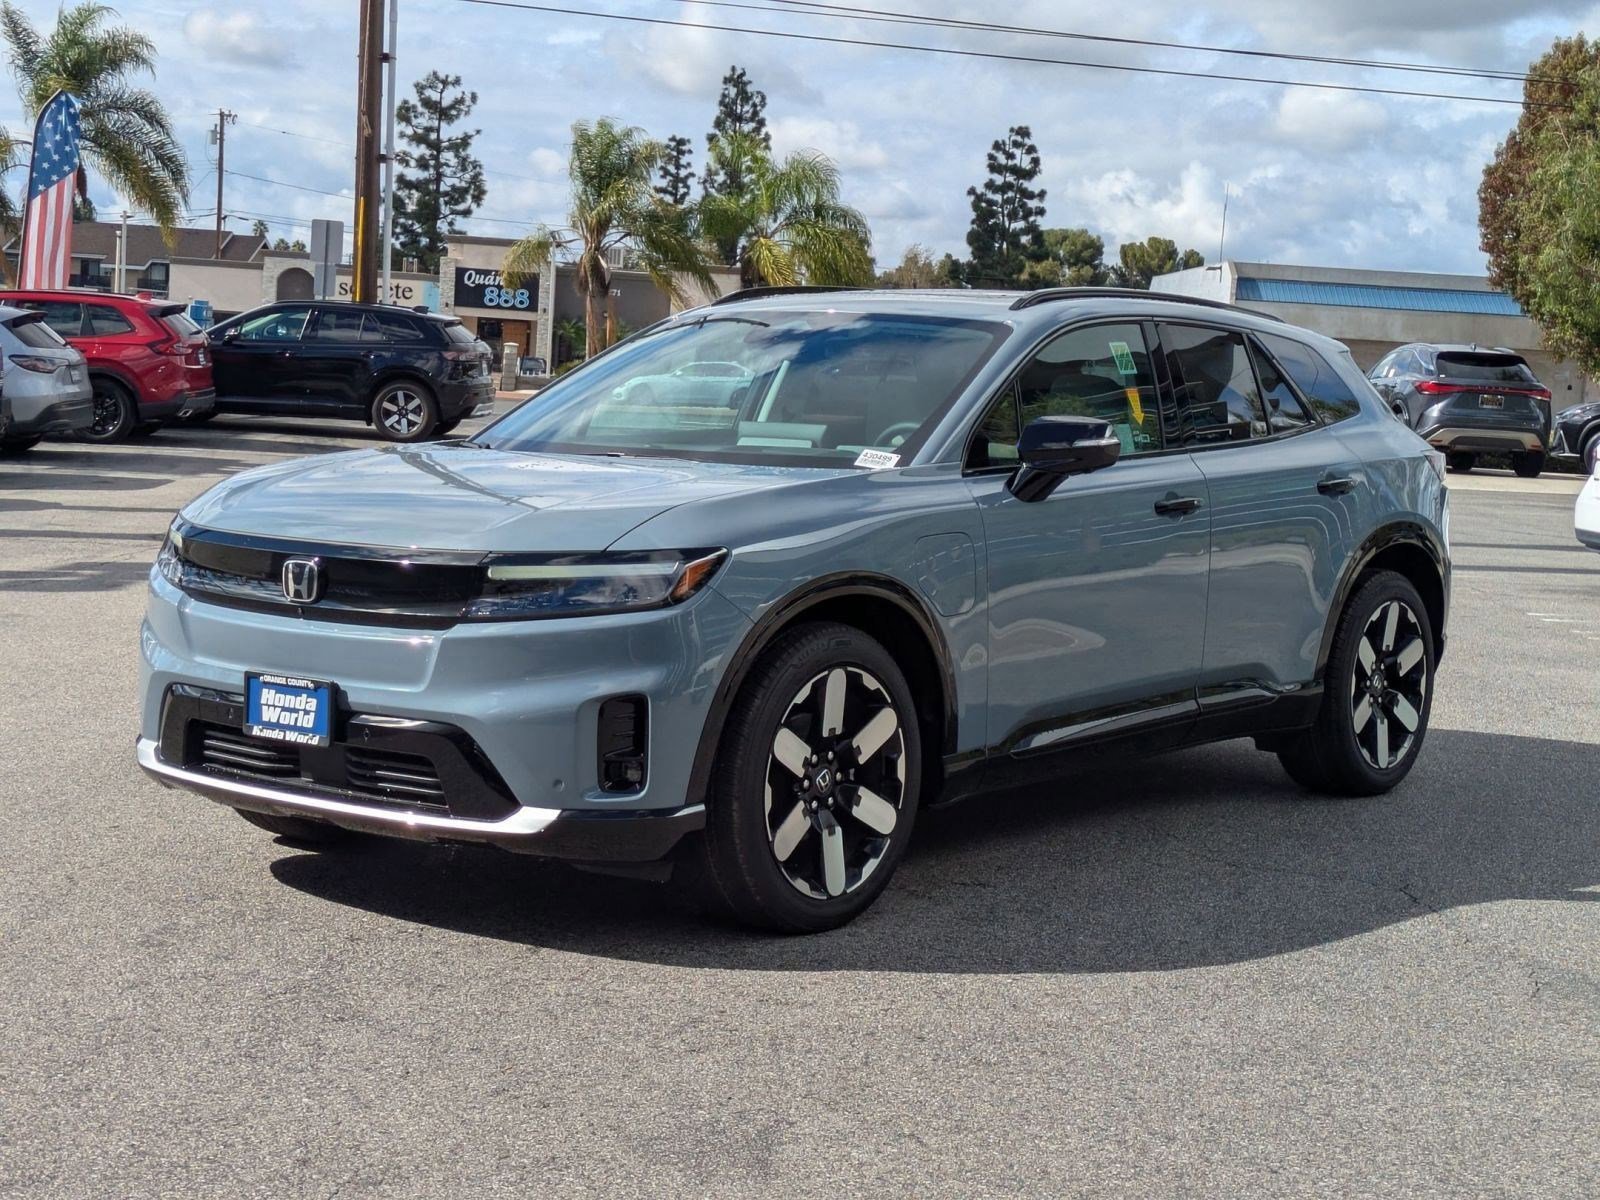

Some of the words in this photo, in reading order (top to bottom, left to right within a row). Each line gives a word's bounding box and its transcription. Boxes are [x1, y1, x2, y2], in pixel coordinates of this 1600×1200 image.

[484, 286, 530, 309] 888
[264, 675, 287, 685] ORANGE
[287, 678, 312, 687] COUNTY
[261, 688, 317, 711] Honda
[262, 705, 315, 728] World
